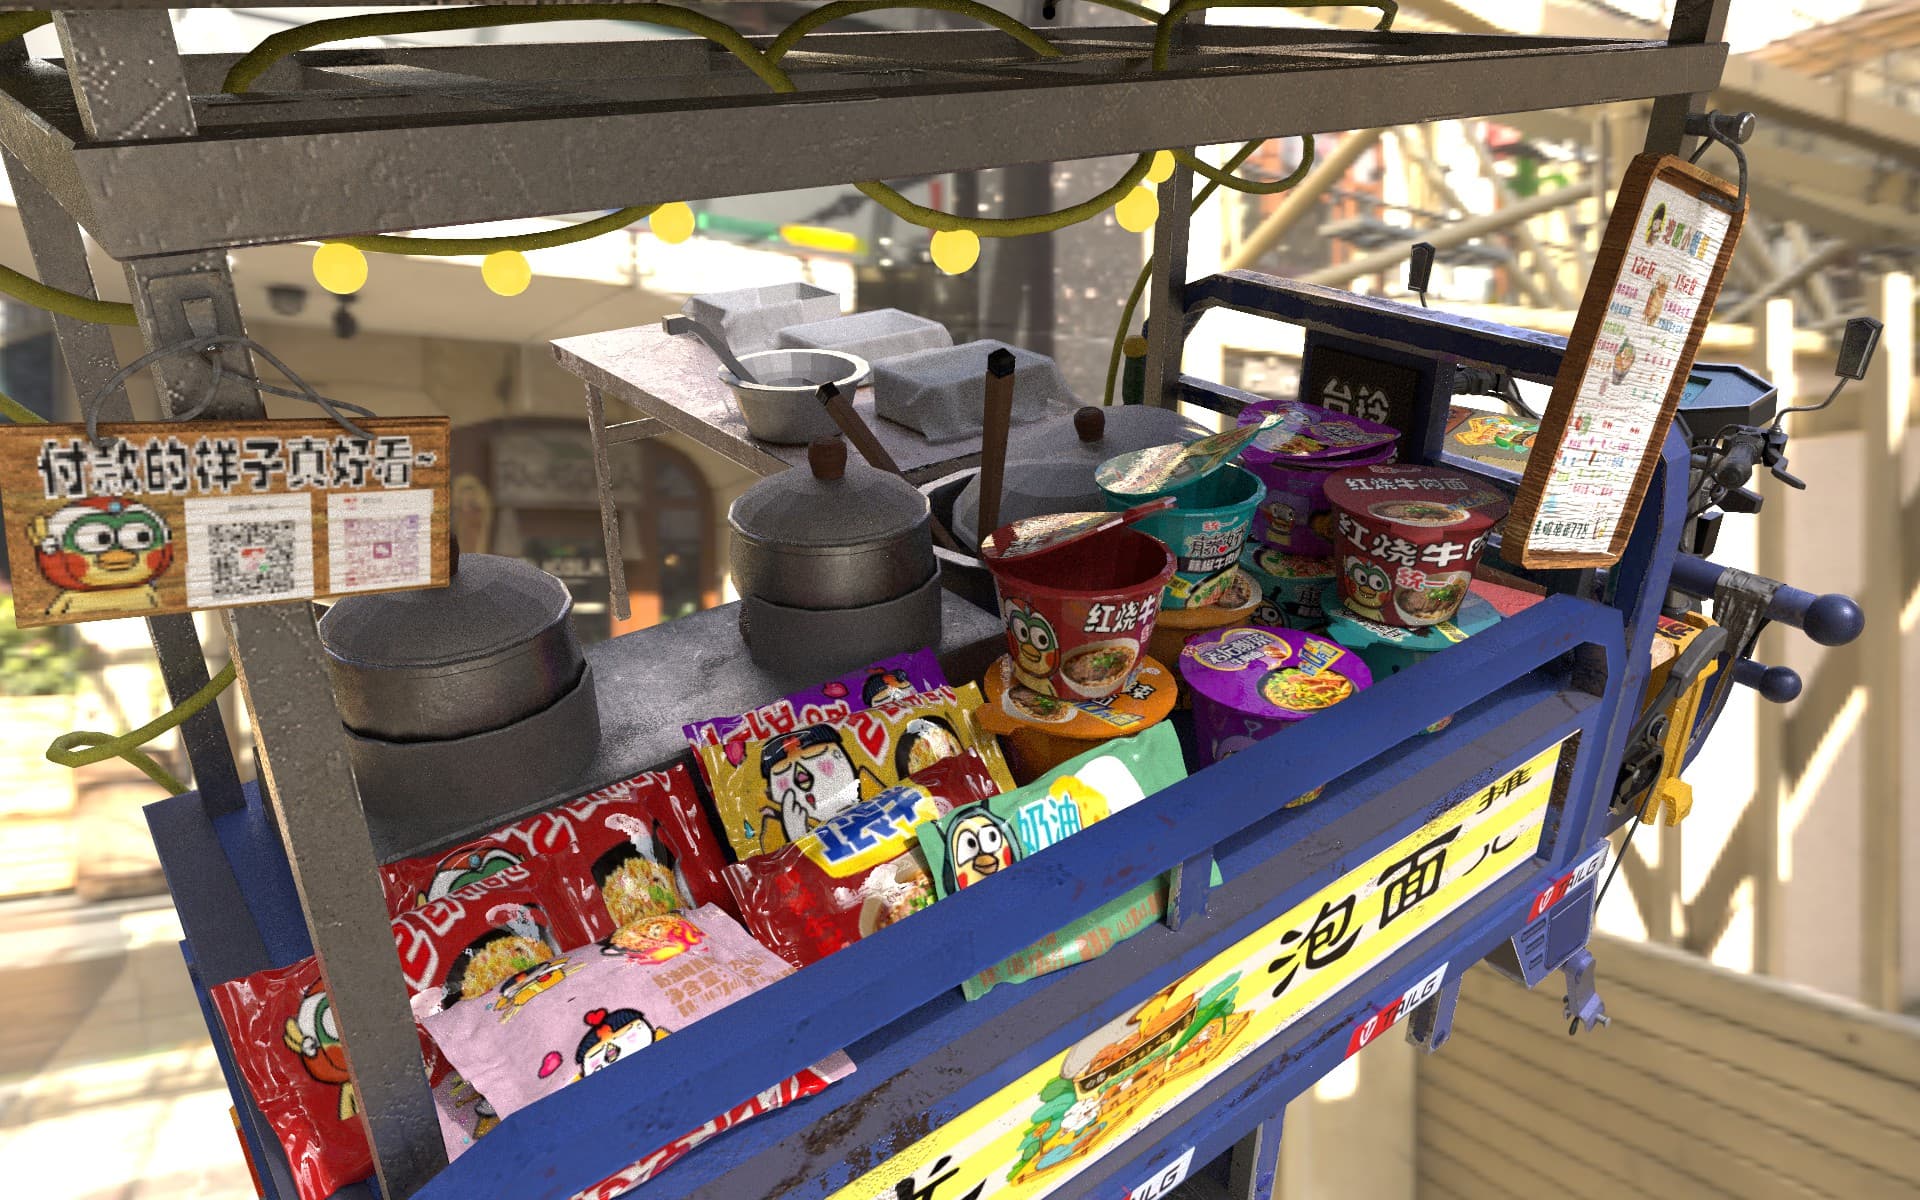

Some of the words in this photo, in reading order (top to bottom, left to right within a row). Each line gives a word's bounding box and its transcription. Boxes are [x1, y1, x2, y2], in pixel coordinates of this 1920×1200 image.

[38, 436, 436, 498] 付款的样子真好看~
